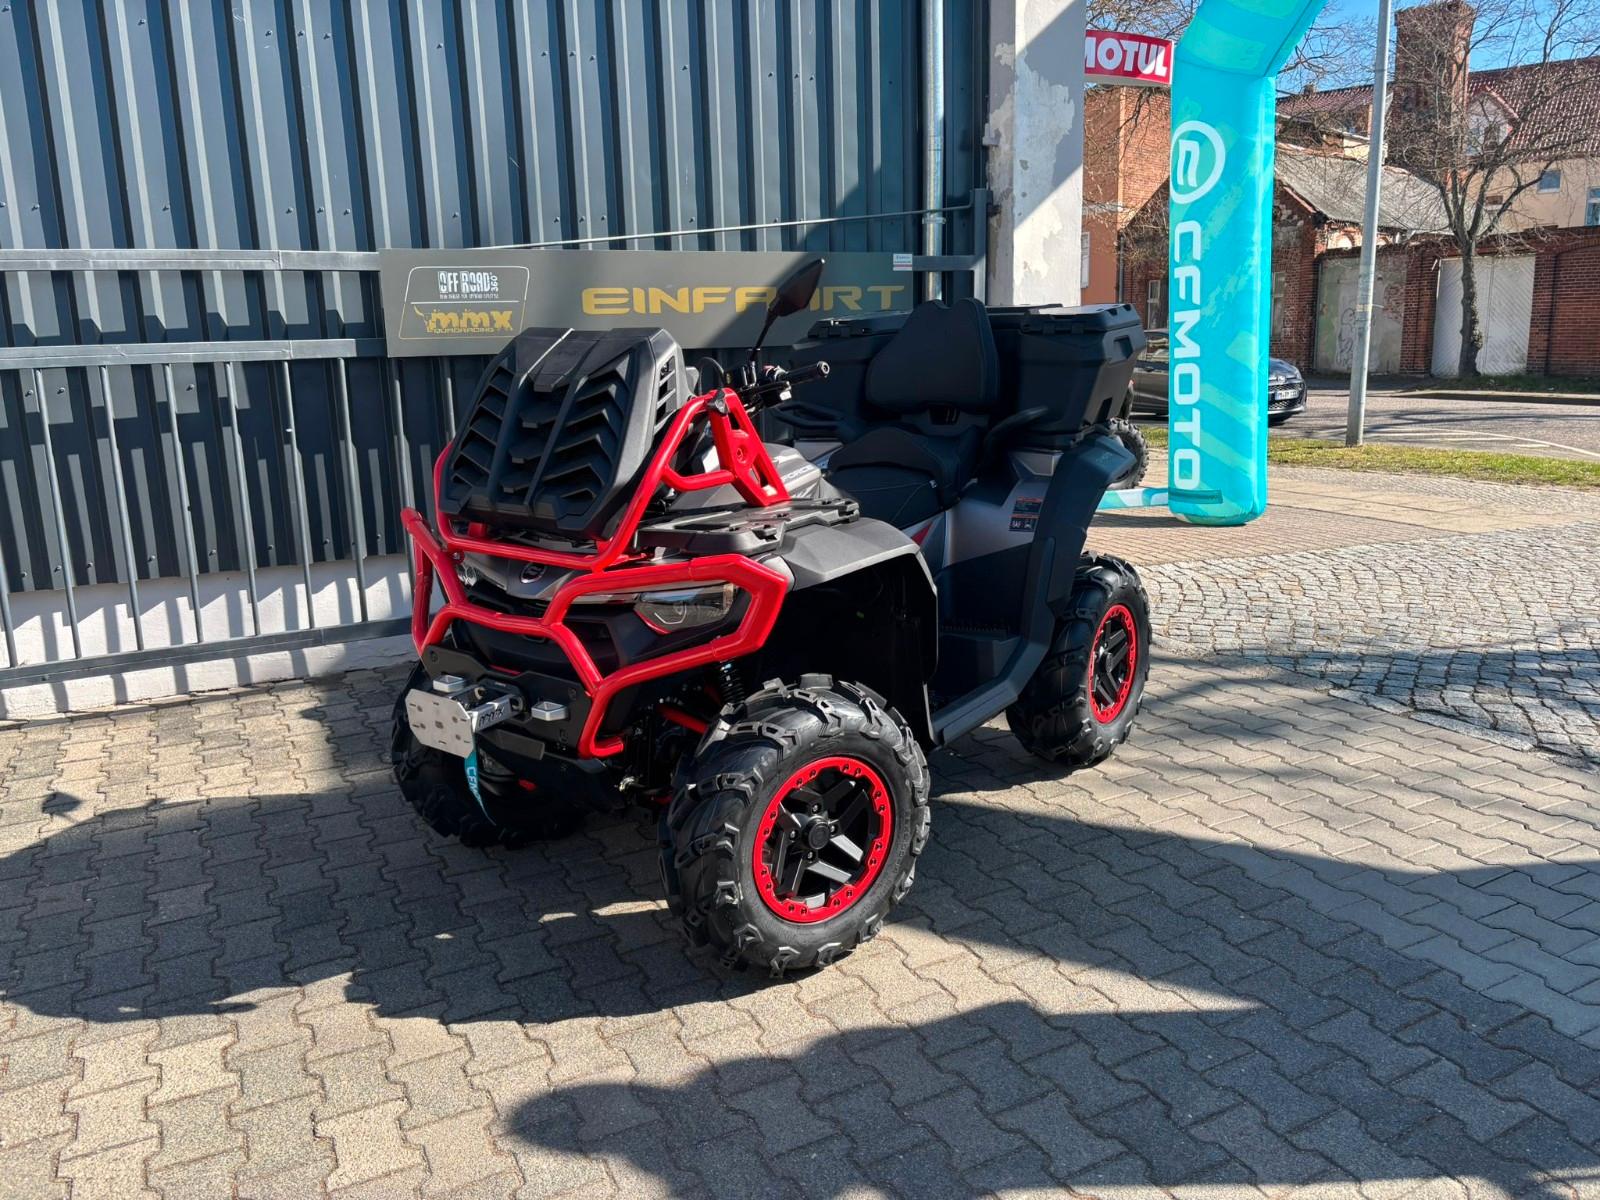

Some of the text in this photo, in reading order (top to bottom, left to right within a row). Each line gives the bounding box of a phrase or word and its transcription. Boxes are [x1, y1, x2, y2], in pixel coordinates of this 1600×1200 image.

[438, 271, 491, 293] OFF ROAD
[1174, 221, 1202, 490] CFMOTO
